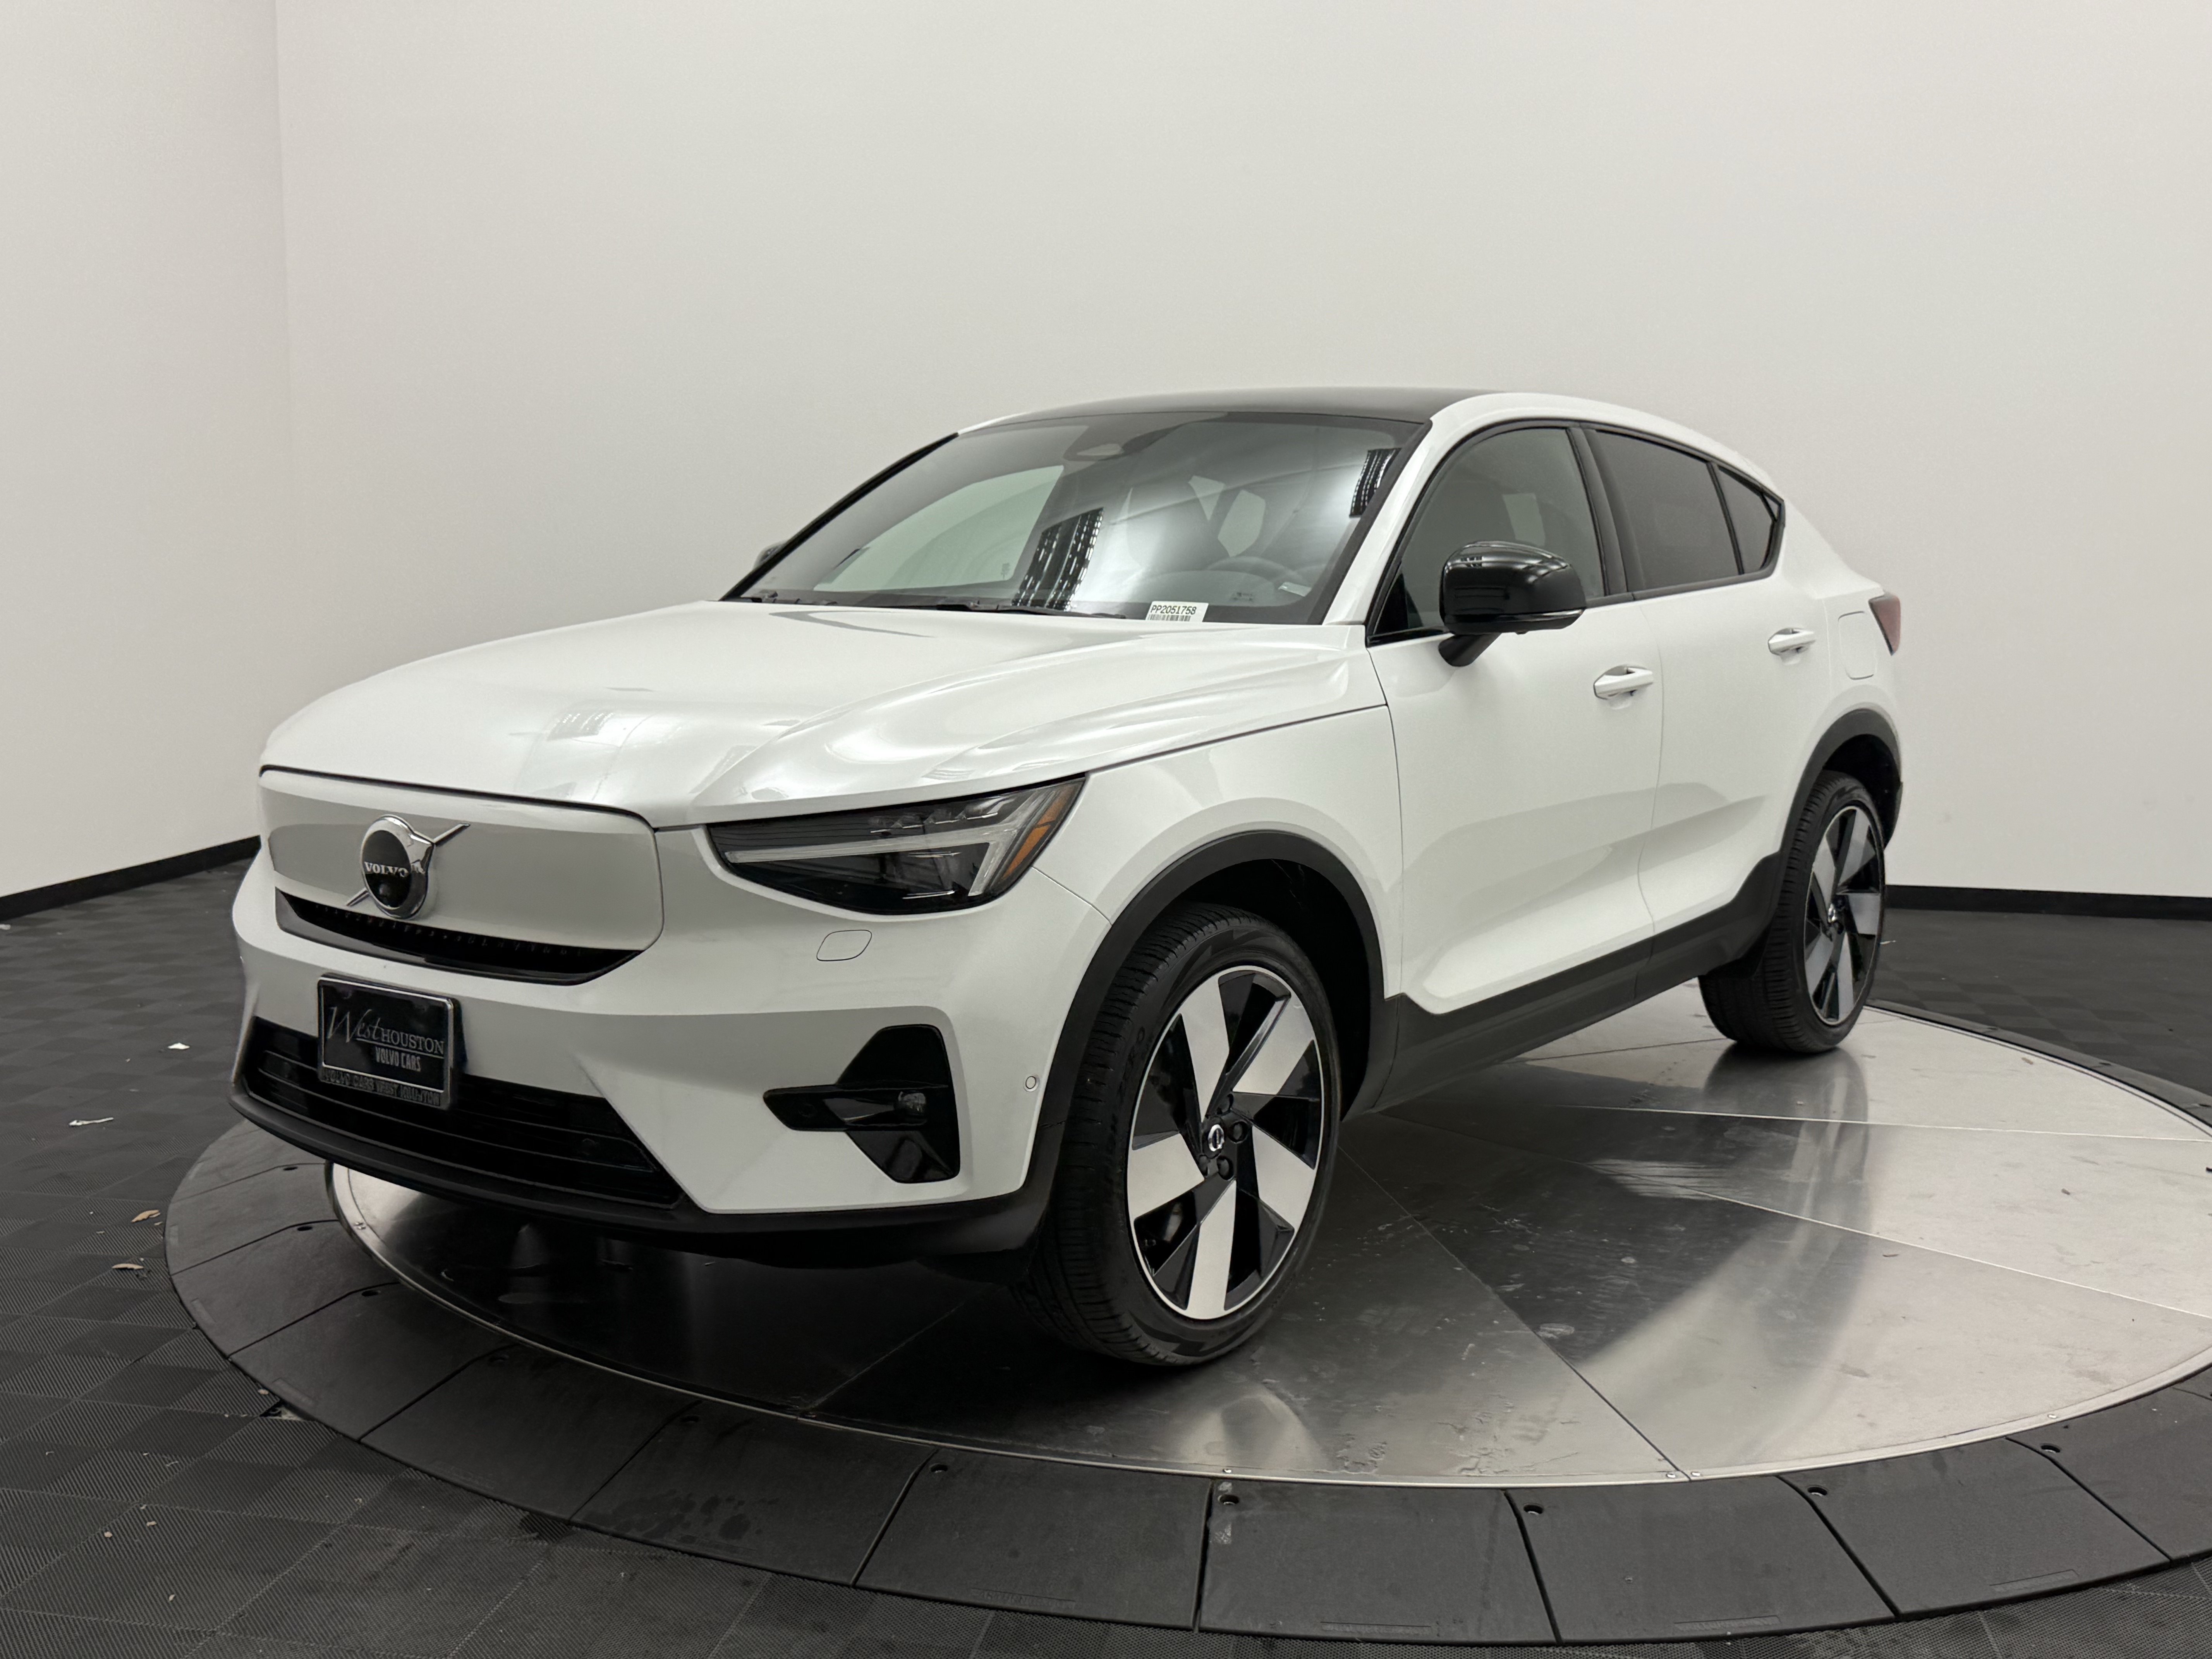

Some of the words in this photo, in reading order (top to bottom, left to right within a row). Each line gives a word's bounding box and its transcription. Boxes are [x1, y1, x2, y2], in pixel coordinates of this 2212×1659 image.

[1151, 605, 1196, 615] PP2051758
[364, 862, 408, 878] VOLVO
[328, 1006, 383, 1043] West
[381, 1029, 444, 1054] HOUSTON
[375, 1047, 399, 1066] VOLVO
[401, 1052, 421, 1072] CARS
